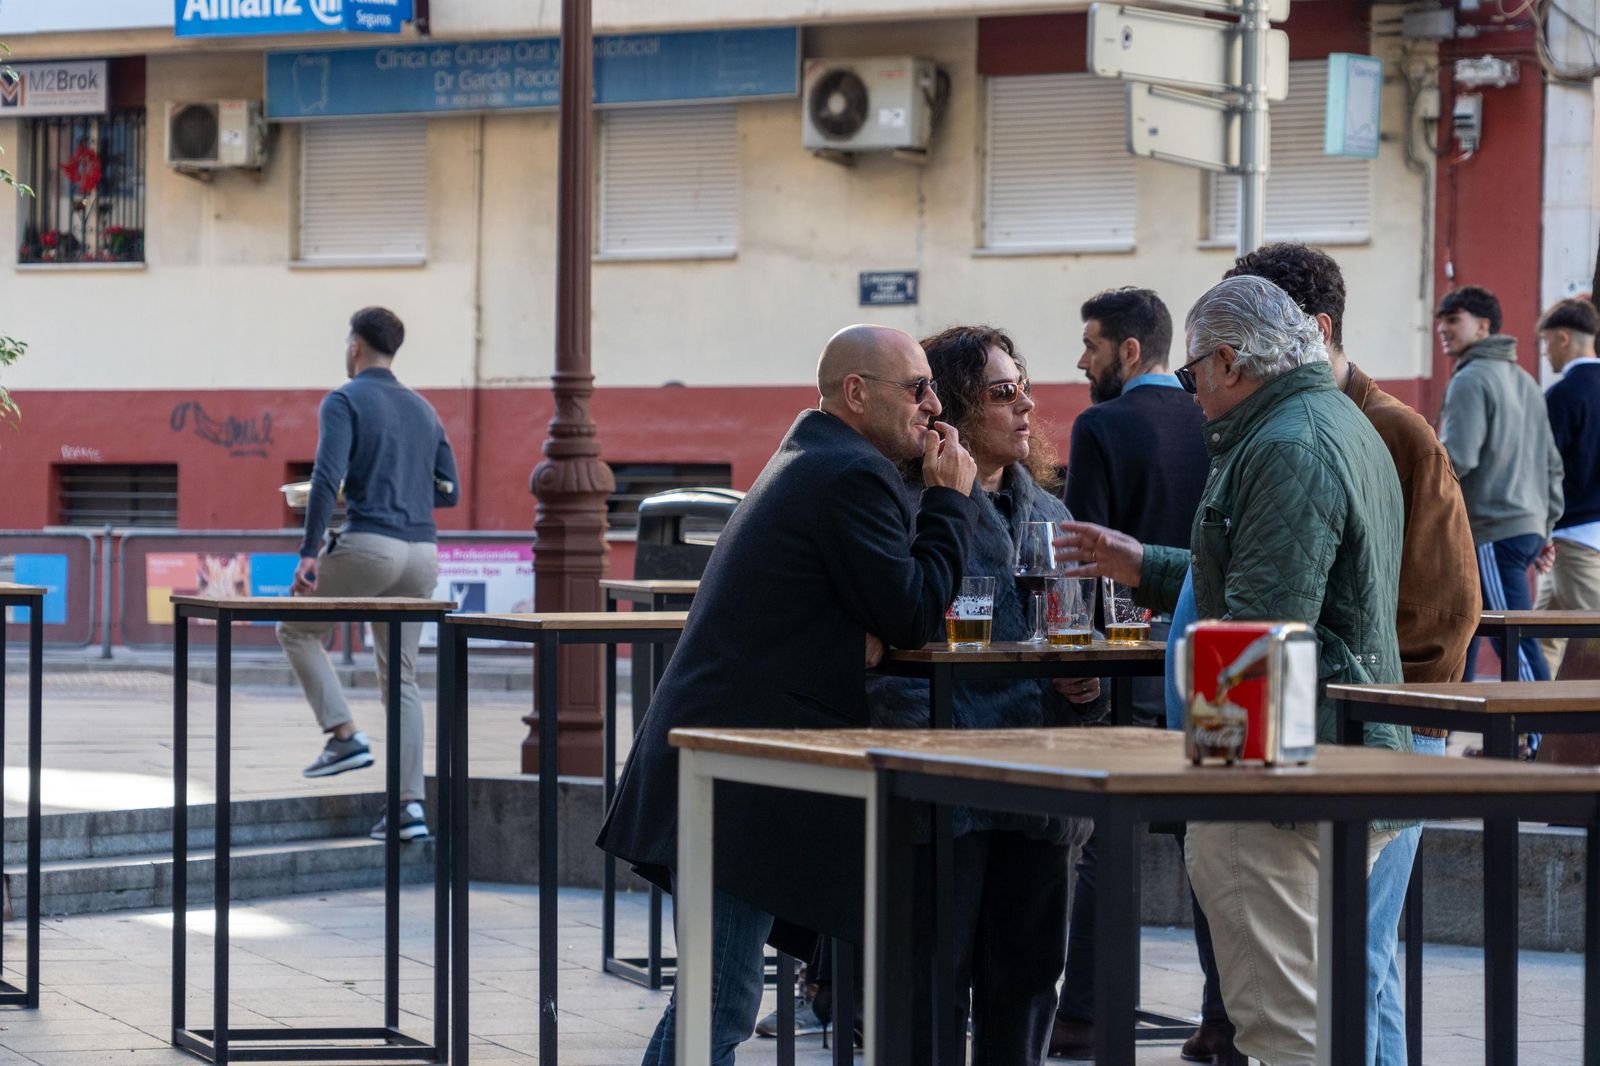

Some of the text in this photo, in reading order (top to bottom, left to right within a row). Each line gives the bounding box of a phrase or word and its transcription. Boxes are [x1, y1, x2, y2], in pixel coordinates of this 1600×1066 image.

[356, 9, 392, 29] Seguros
[430, 48, 452, 67] de
[514, 41, 549, 64] Oral
[28, 68, 99, 91] M2Brok
[434, 70, 455, 92] Dr
